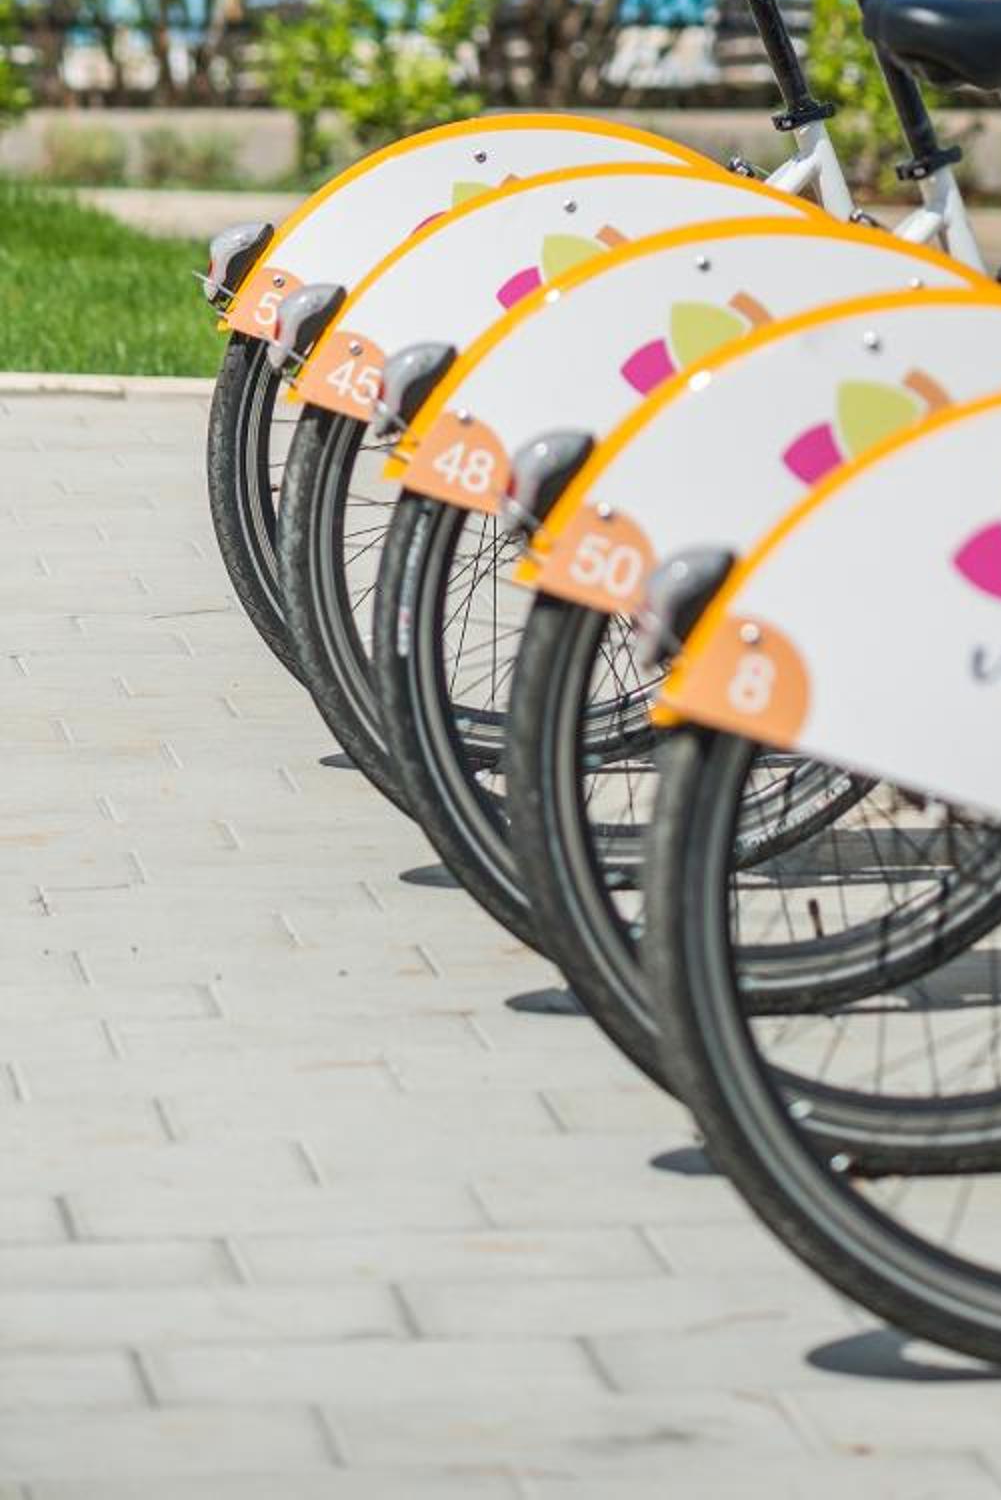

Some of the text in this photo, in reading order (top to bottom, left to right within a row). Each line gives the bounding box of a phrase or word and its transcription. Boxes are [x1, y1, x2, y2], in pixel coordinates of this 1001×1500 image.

[326, 360, 381, 405] 45
[432, 440, 495, 493] 48
[570, 532, 642, 599] 50
[729, 653, 775, 714] 8
